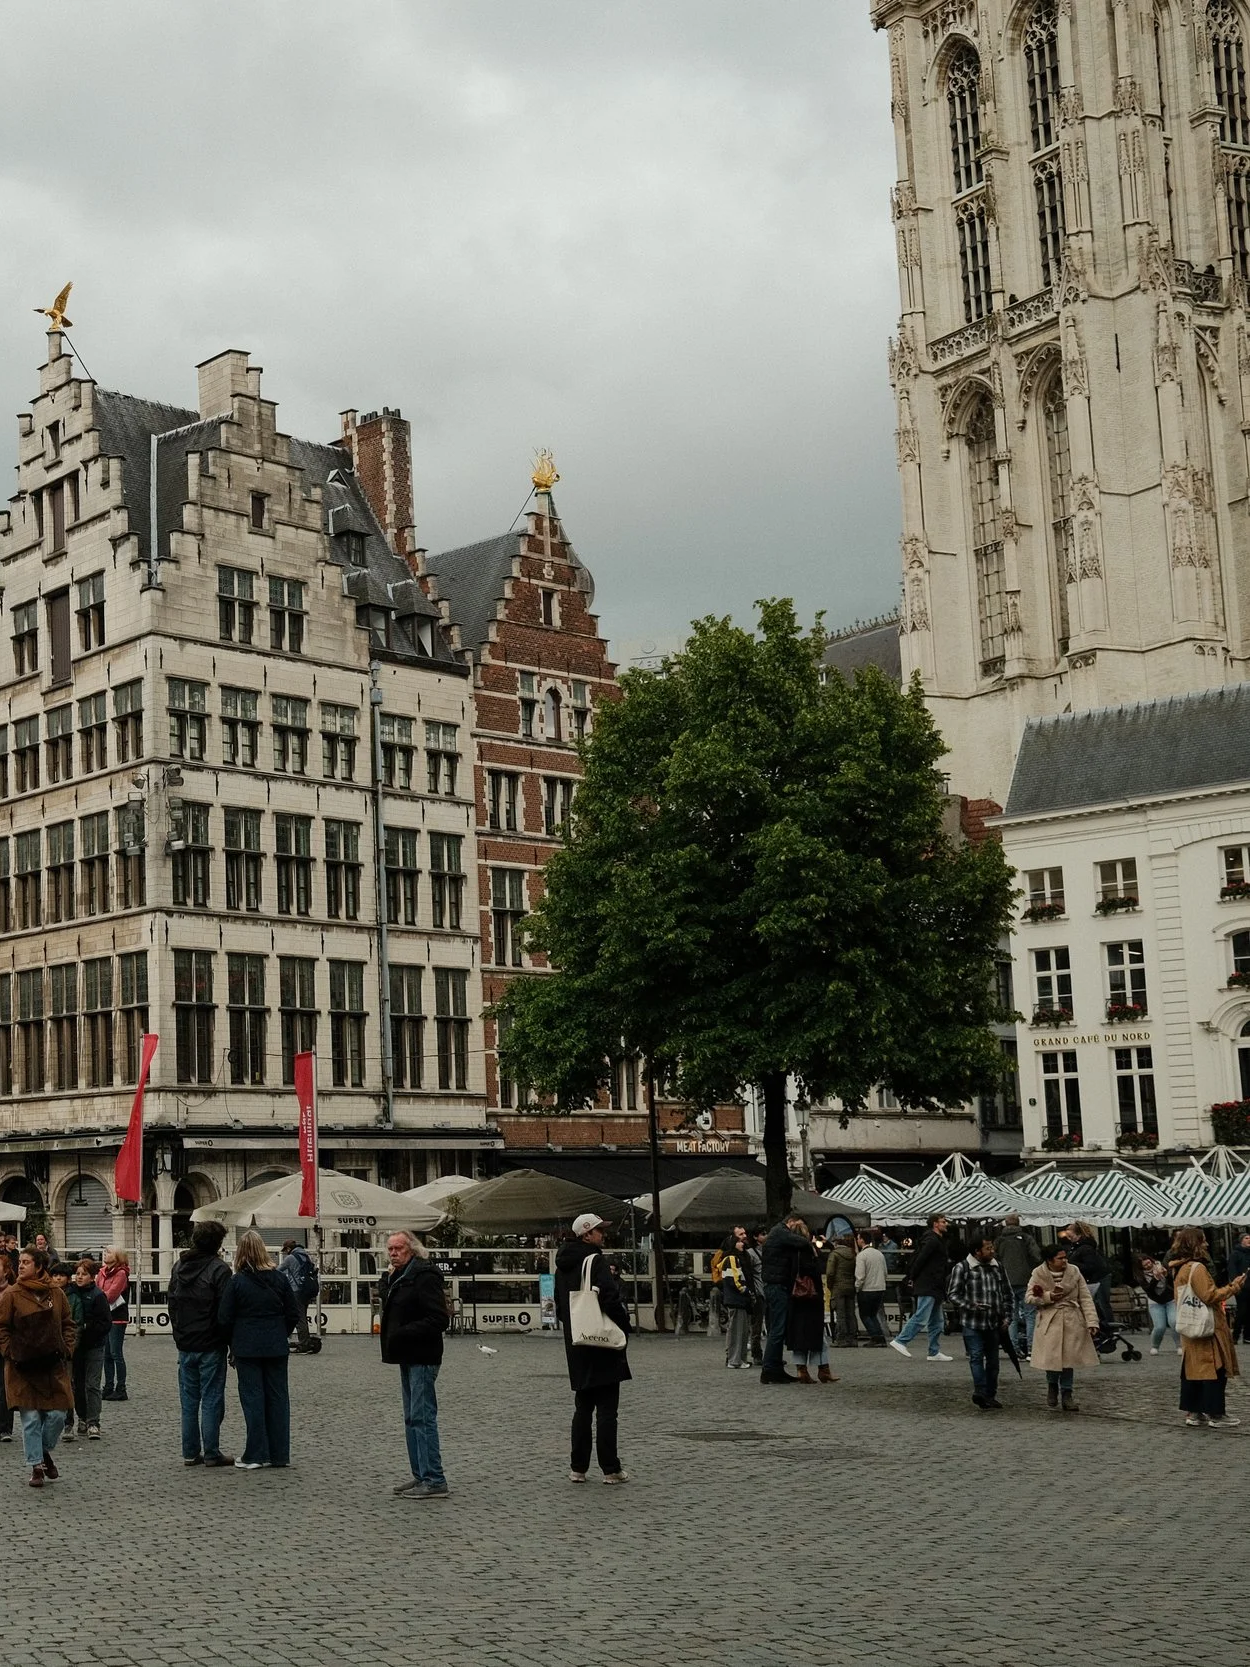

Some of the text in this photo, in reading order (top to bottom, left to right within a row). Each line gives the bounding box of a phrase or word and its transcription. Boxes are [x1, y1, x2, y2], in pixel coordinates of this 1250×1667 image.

[1033, 1037, 1069, 1047] GRAND
[1104, 1034, 1118, 1042] DU
[1122, 1032, 1151, 1041] NORD
[676, 1140, 730, 1153] MEAT FACTORY
[482, 1315, 516, 1323] SUPER
